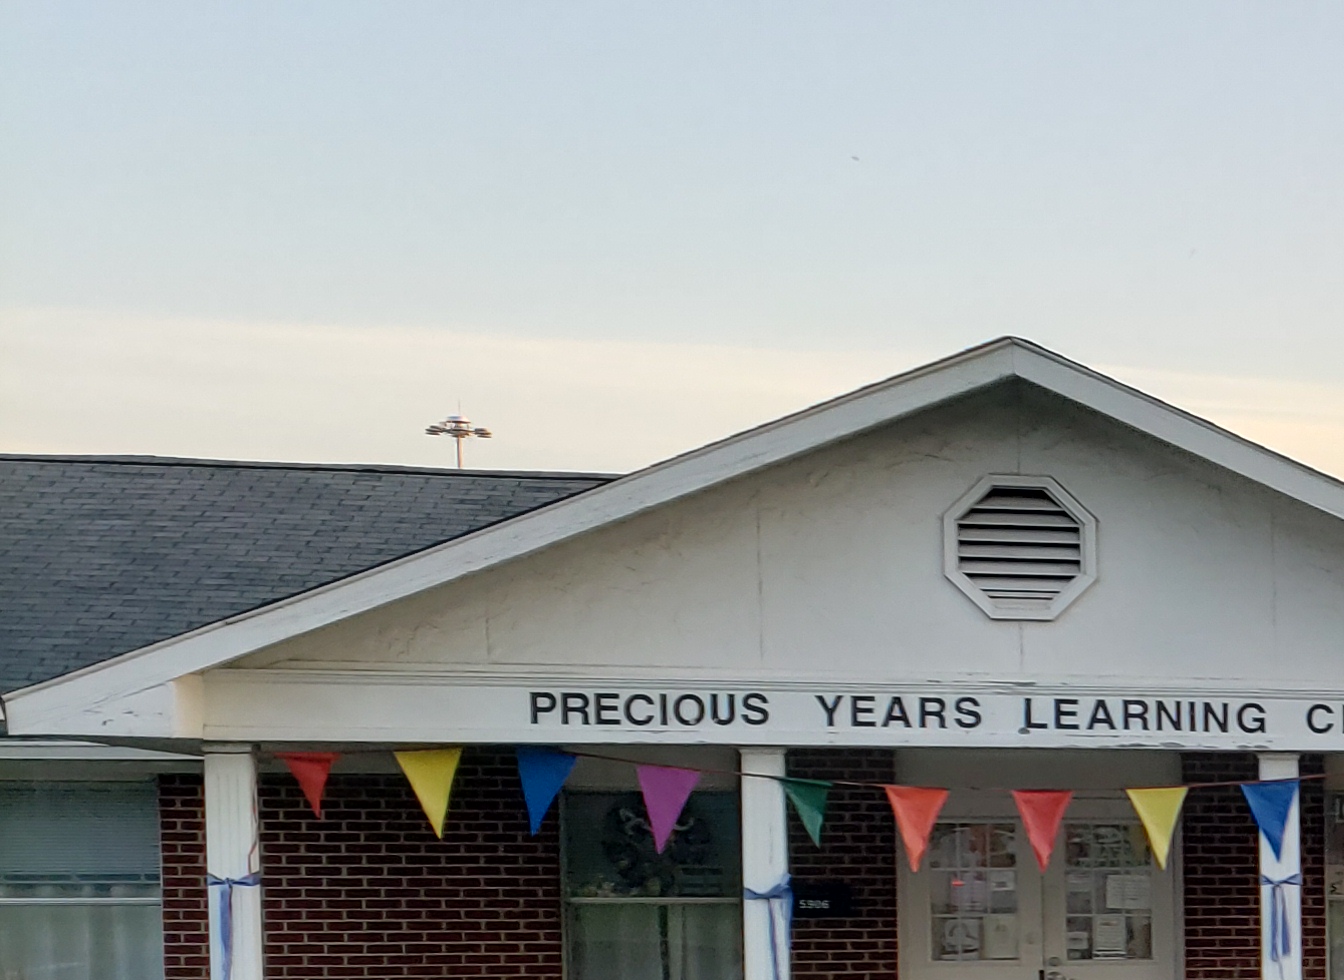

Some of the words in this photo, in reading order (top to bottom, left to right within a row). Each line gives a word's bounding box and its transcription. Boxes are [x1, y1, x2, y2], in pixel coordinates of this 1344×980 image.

[528, 691, 770, 726] PRECIOUS
[815, 694, 983, 728] YEARS
[1024, 698, 1267, 734] LEARNING
